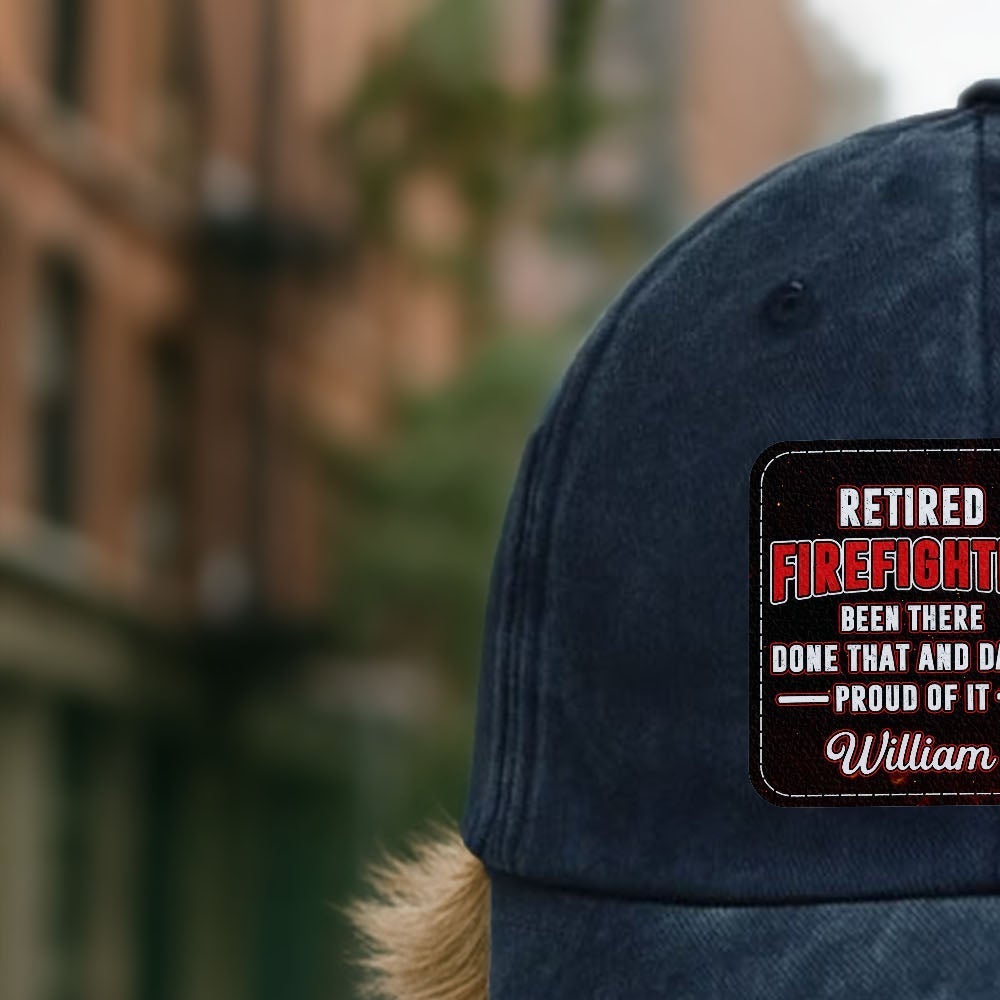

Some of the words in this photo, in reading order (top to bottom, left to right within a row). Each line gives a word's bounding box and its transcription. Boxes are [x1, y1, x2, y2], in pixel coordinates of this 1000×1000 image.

[840, 487, 985, 527] RETIRED
[841, 605, 900, 632] BEEN
[908, 604, 984, 631] THERE
[772, 644, 838, 672] DONE
[847, 644, 910, 671] THAT
[918, 643, 969, 671] AND
[835, 684, 918, 712] PROUD
[928, 684, 957, 711] OF
[967, 683, 989, 710] IT
[826, 730, 997, 775] William
